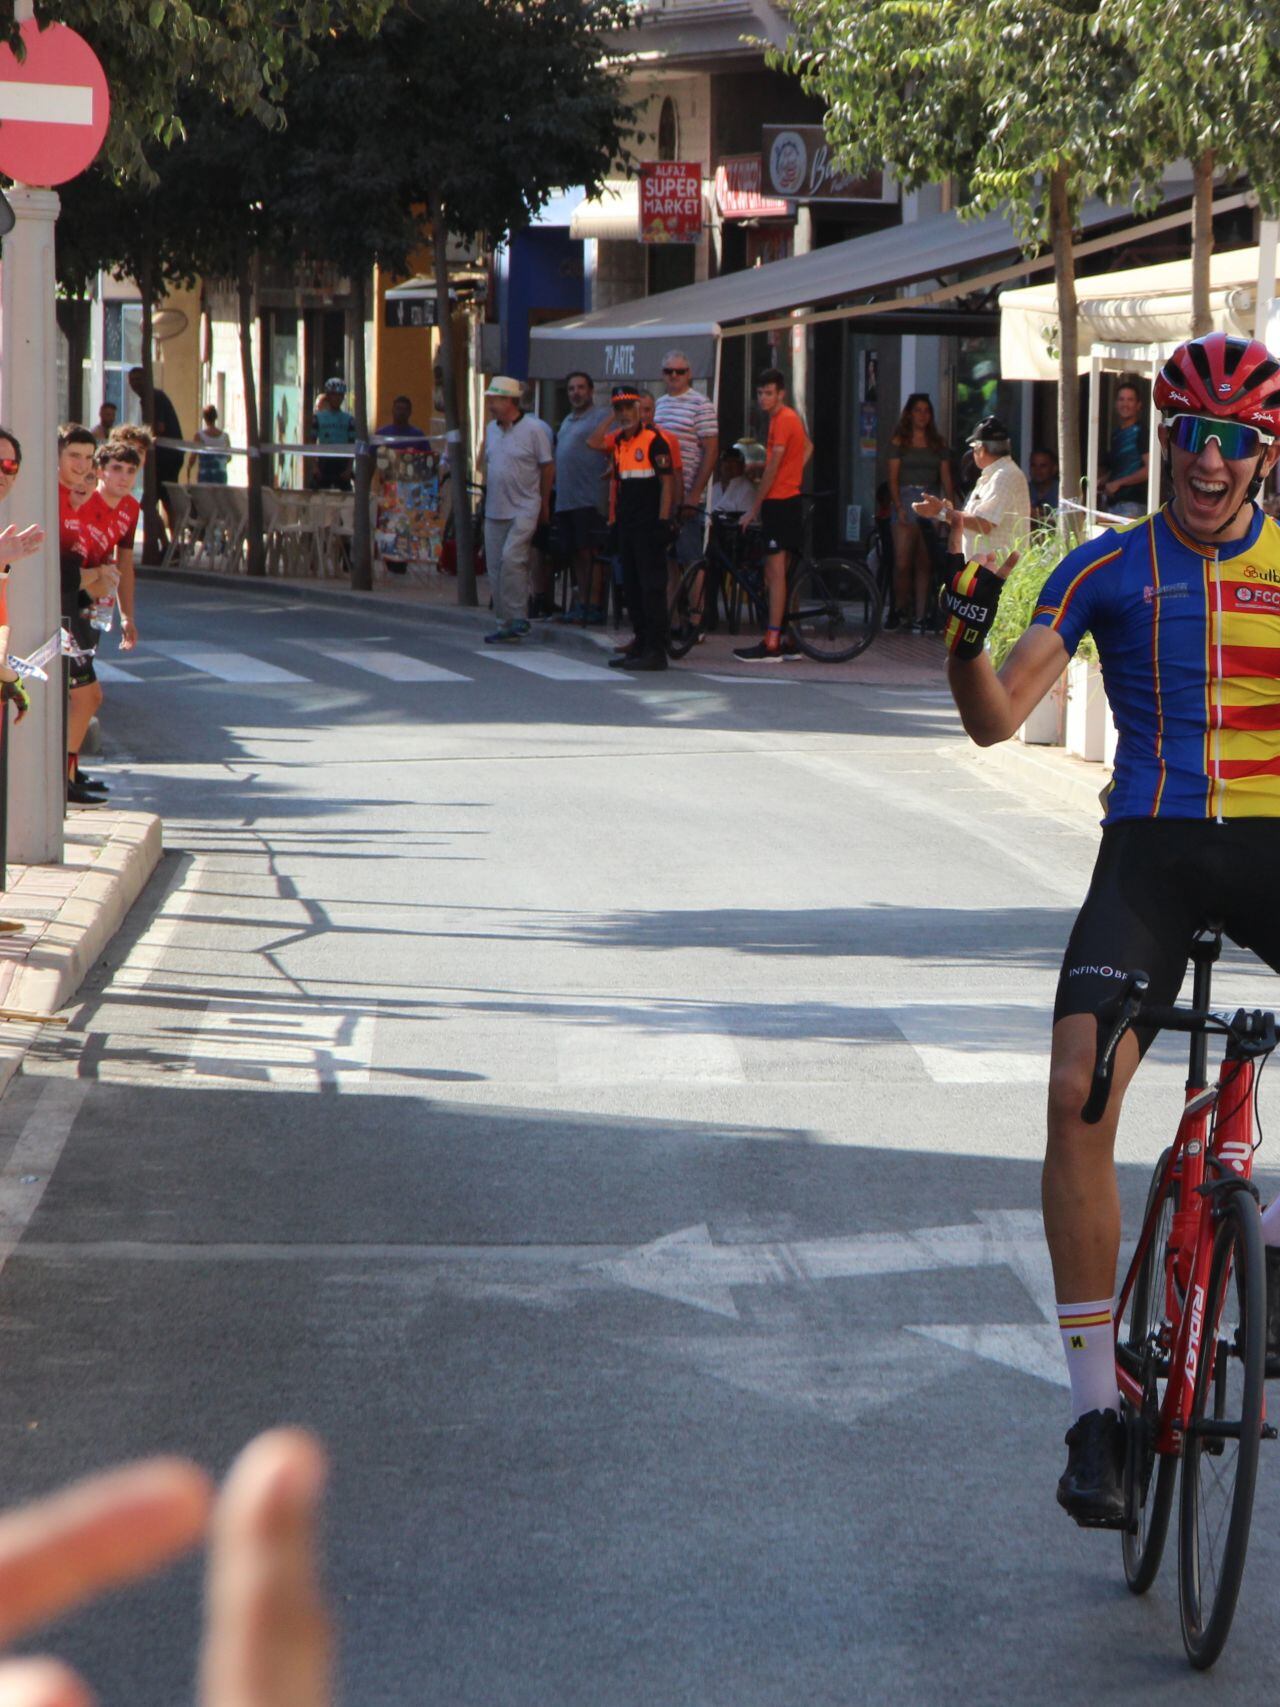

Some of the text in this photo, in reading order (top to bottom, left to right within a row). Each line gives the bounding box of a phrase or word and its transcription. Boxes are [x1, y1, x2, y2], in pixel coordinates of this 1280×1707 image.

[655, 165, 688, 177] ALFAZ
[645, 178, 698, 198] SUPER
[643, 199, 699, 216] MARKET
